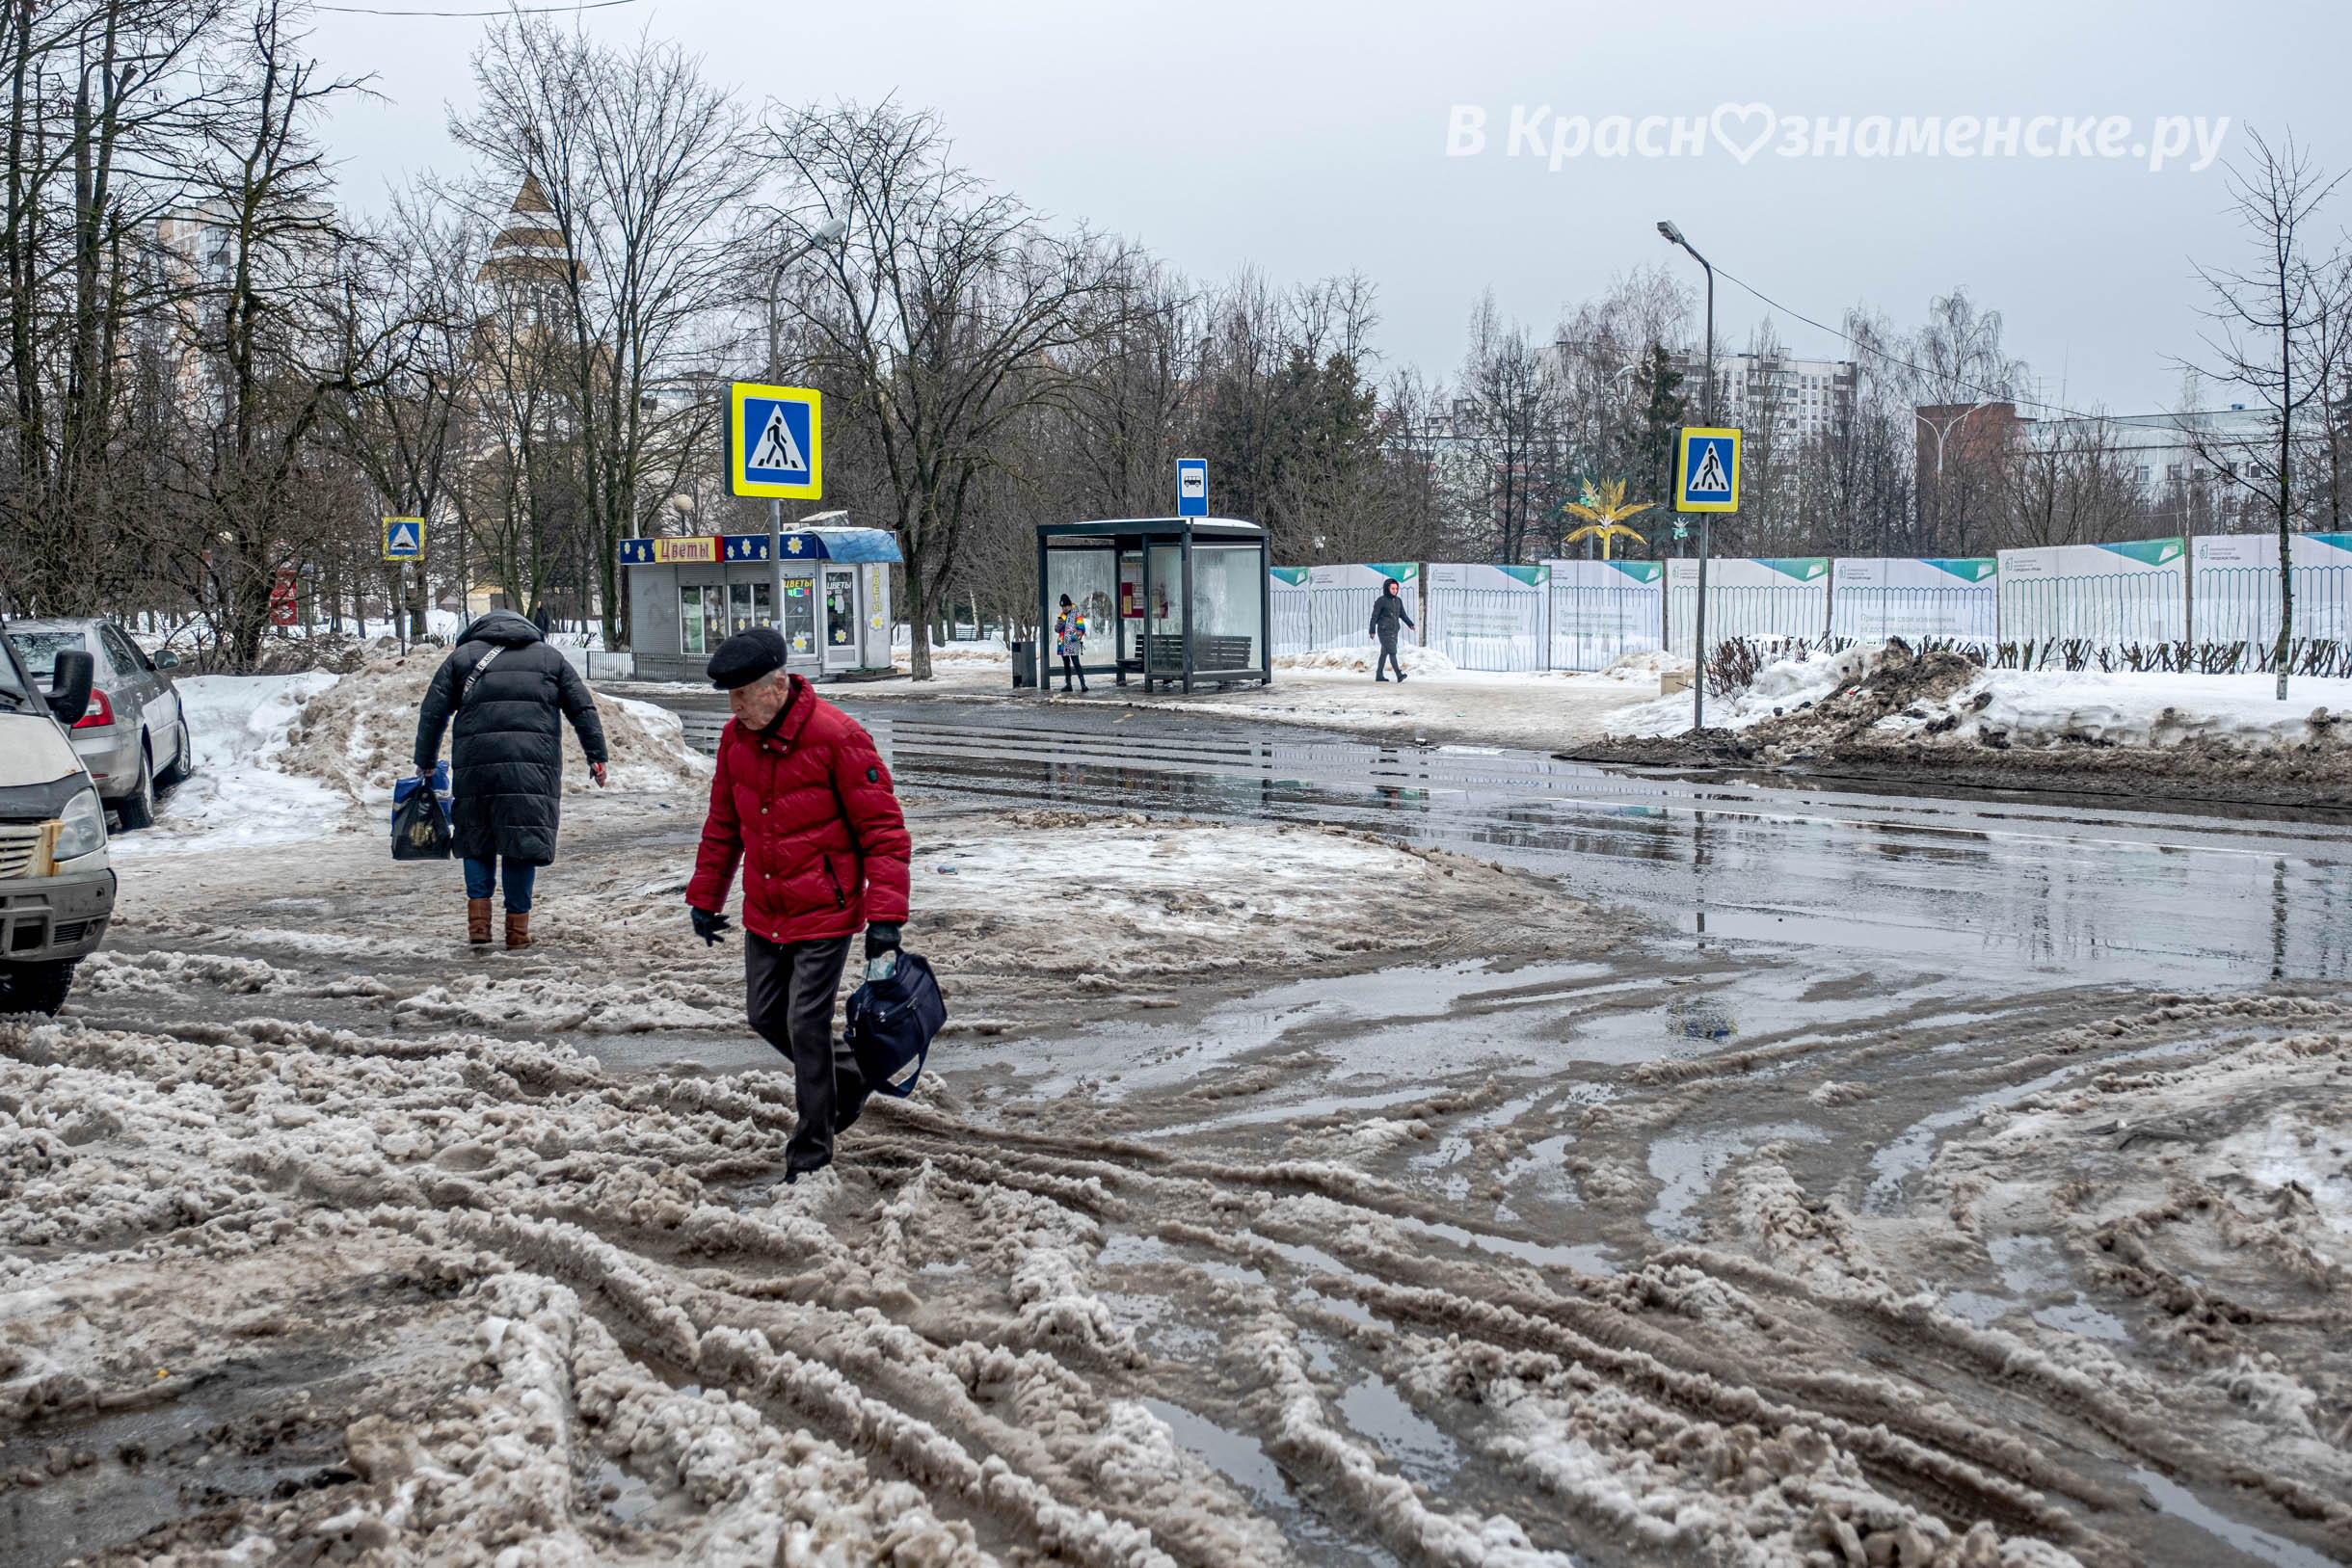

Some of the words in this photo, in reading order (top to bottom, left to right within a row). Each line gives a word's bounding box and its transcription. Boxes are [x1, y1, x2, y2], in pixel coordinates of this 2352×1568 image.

[661, 540, 709, 561] Цветы
[784, 579, 813, 589] ЦВЕТЫ
[826, 581, 852, 590] ЦВЕТЫ
[872, 567, 882, 611] ЦВЕТЫ
